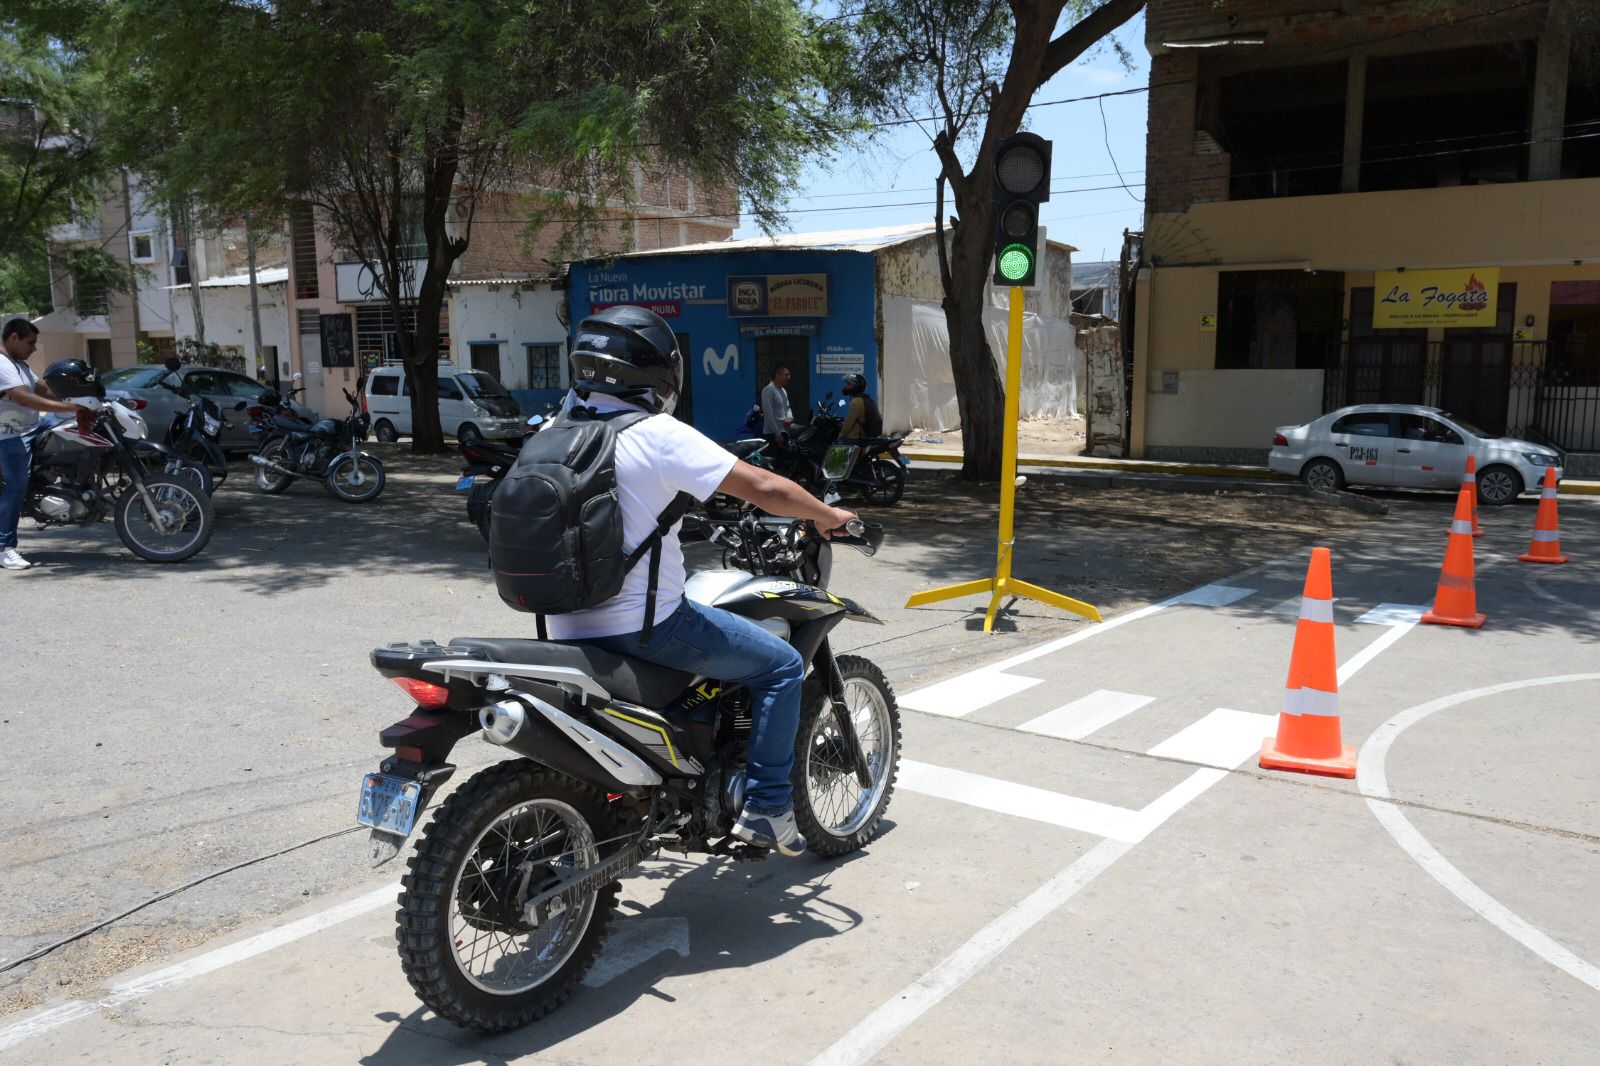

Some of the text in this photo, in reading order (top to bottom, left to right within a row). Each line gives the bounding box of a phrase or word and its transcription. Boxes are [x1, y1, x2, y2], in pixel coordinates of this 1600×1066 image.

[589, 272, 628, 283] La Nueva
[589, 281, 706, 302] Fibra Movistar
[738, 288, 757, 297] INCA
[1381, 285, 1489, 309] La Fogata
[737, 297, 758, 305] KOLA
[651, 304, 677, 315] PIURA
